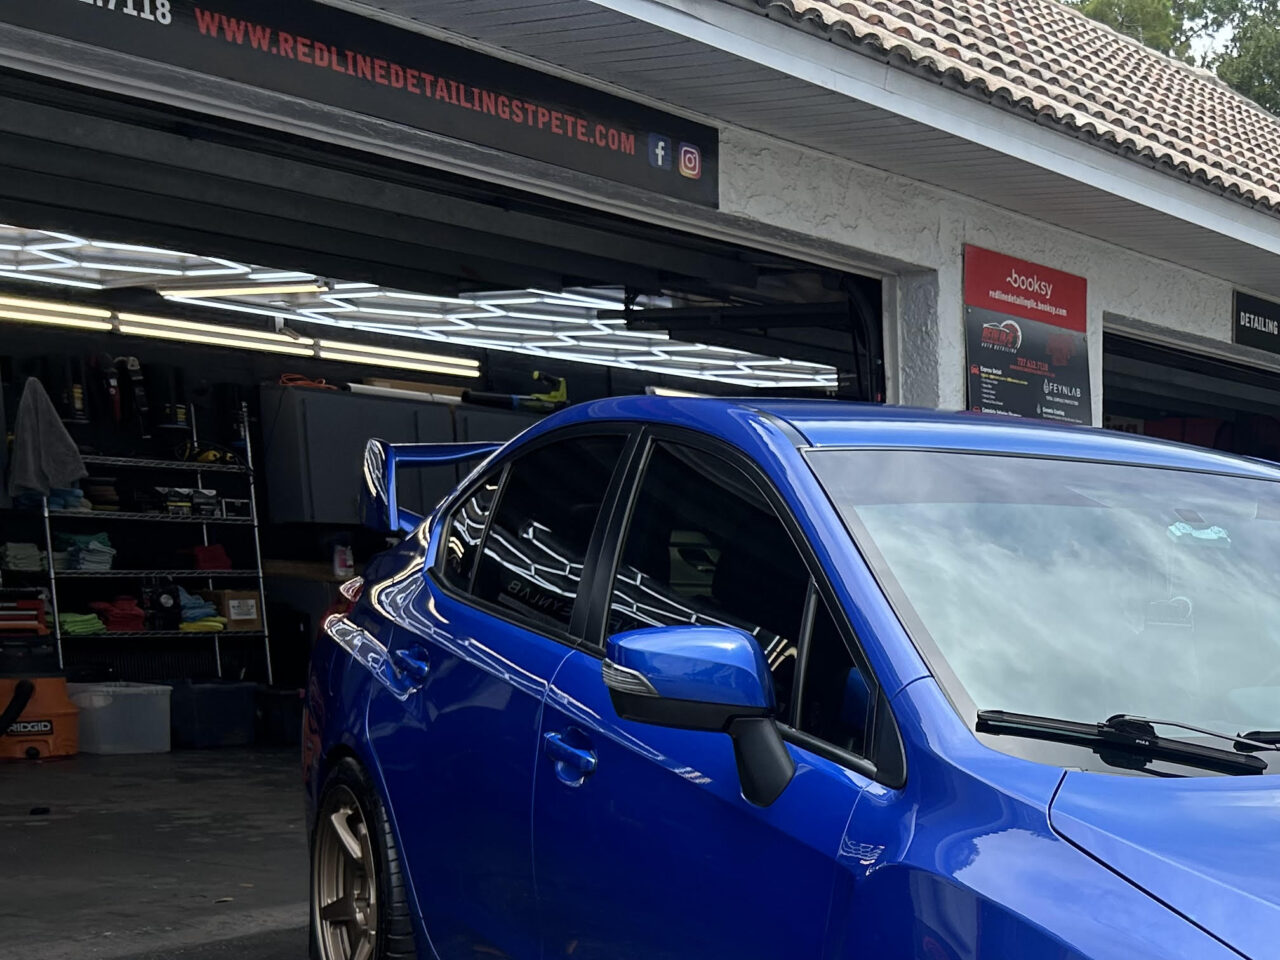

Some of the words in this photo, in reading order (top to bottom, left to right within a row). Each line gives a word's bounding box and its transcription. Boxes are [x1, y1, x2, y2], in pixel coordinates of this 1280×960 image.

[194, 7, 636, 155] WWW.REDLINEDETAILINGSTPETE.COM
[1006, 268, 1053, 299] booksy
[1240, 311, 1278, 335] DETAILING
[1049, 382, 1081, 398] FEYNLAB
[8, 722, 51, 732] RIDGID
